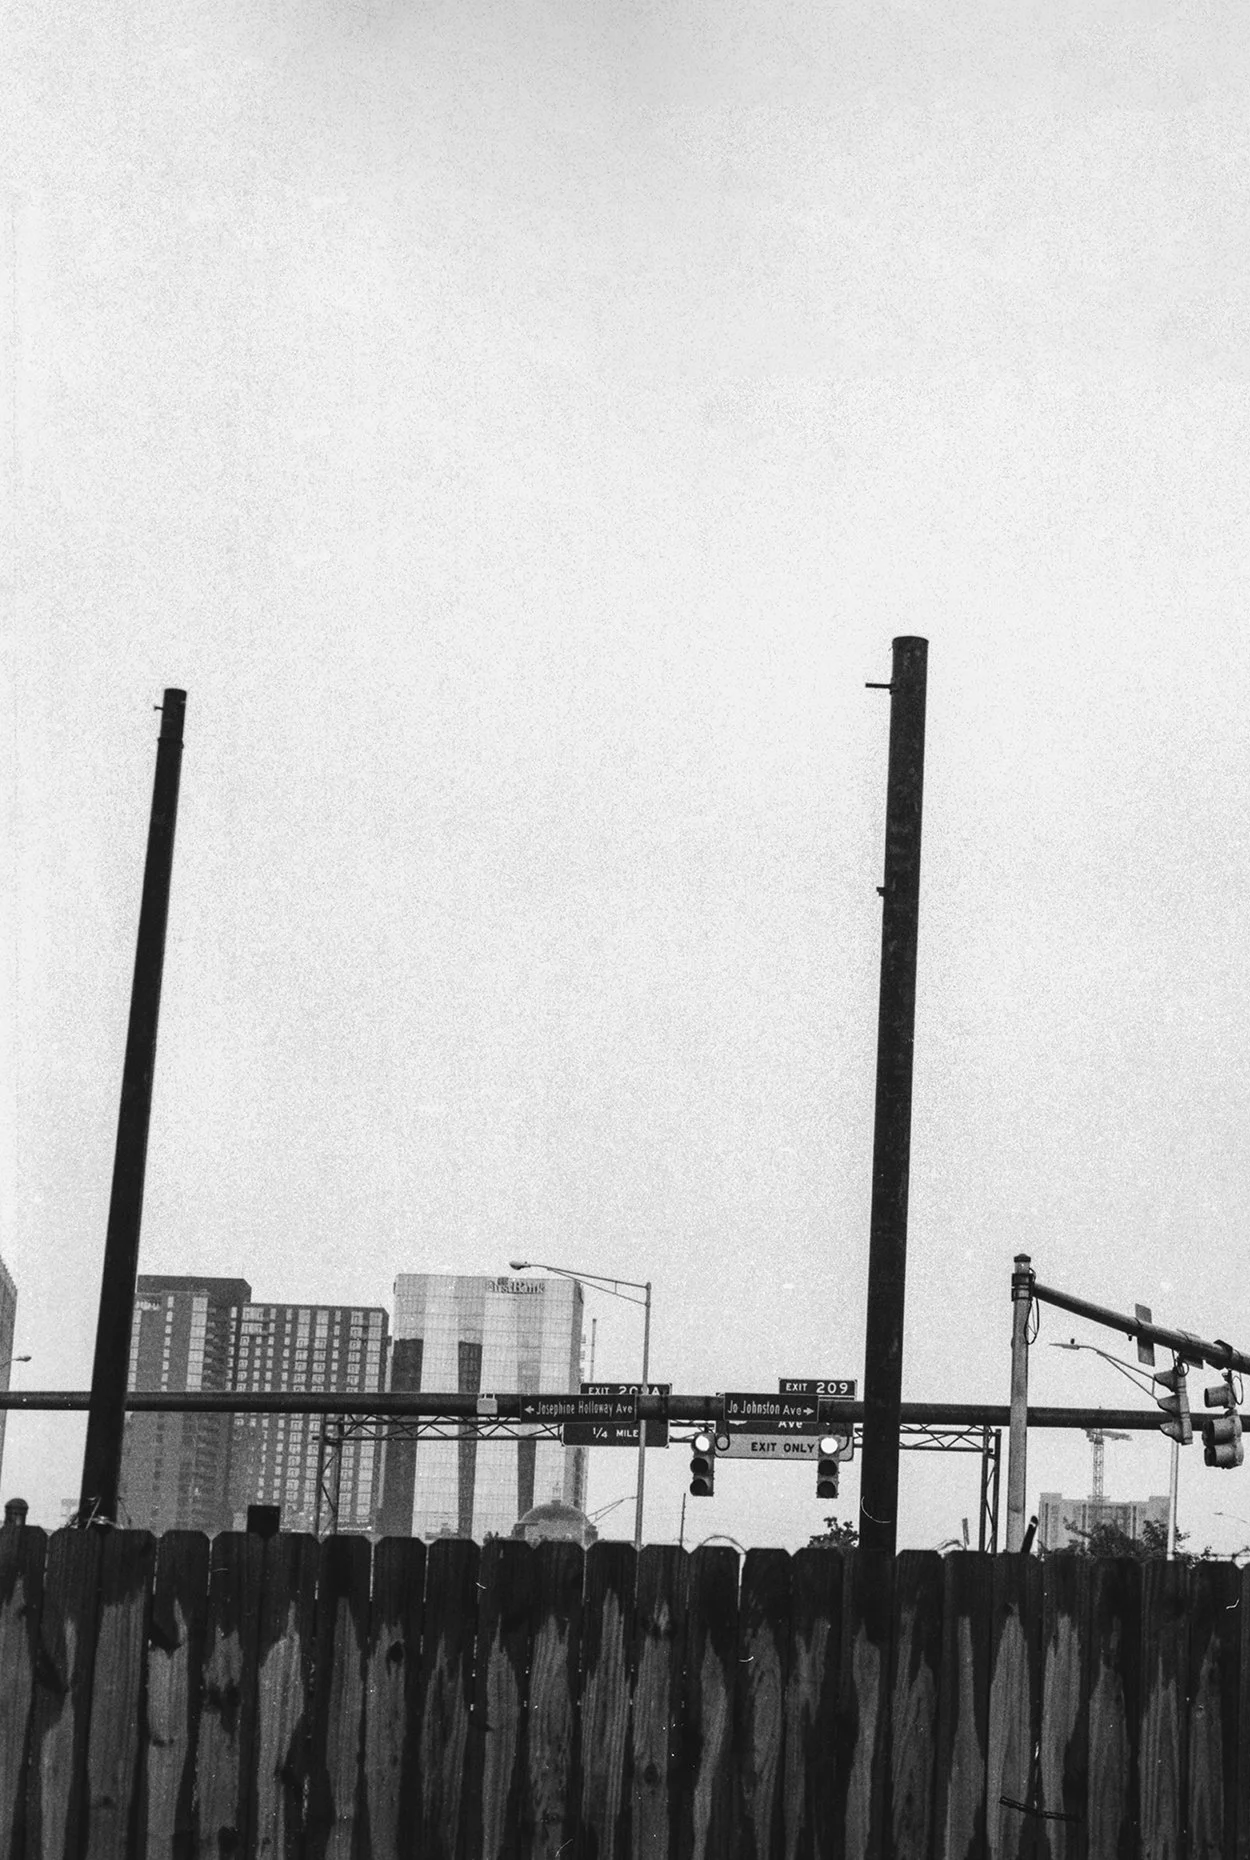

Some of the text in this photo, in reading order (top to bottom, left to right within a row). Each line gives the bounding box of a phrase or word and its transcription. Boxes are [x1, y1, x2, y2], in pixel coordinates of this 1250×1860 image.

[588, 1386, 609, 1395] EXIT
[785, 1382, 849, 1394] EXIT 209
[536, 1401, 633, 1417] Josephine Holloway Ave
[728, 1400, 802, 1416] Jo Johnston Ave
[592, 1427, 639, 1439] 1/4 MILE
[751, 1442, 815, 1454] EXIT ONLY
